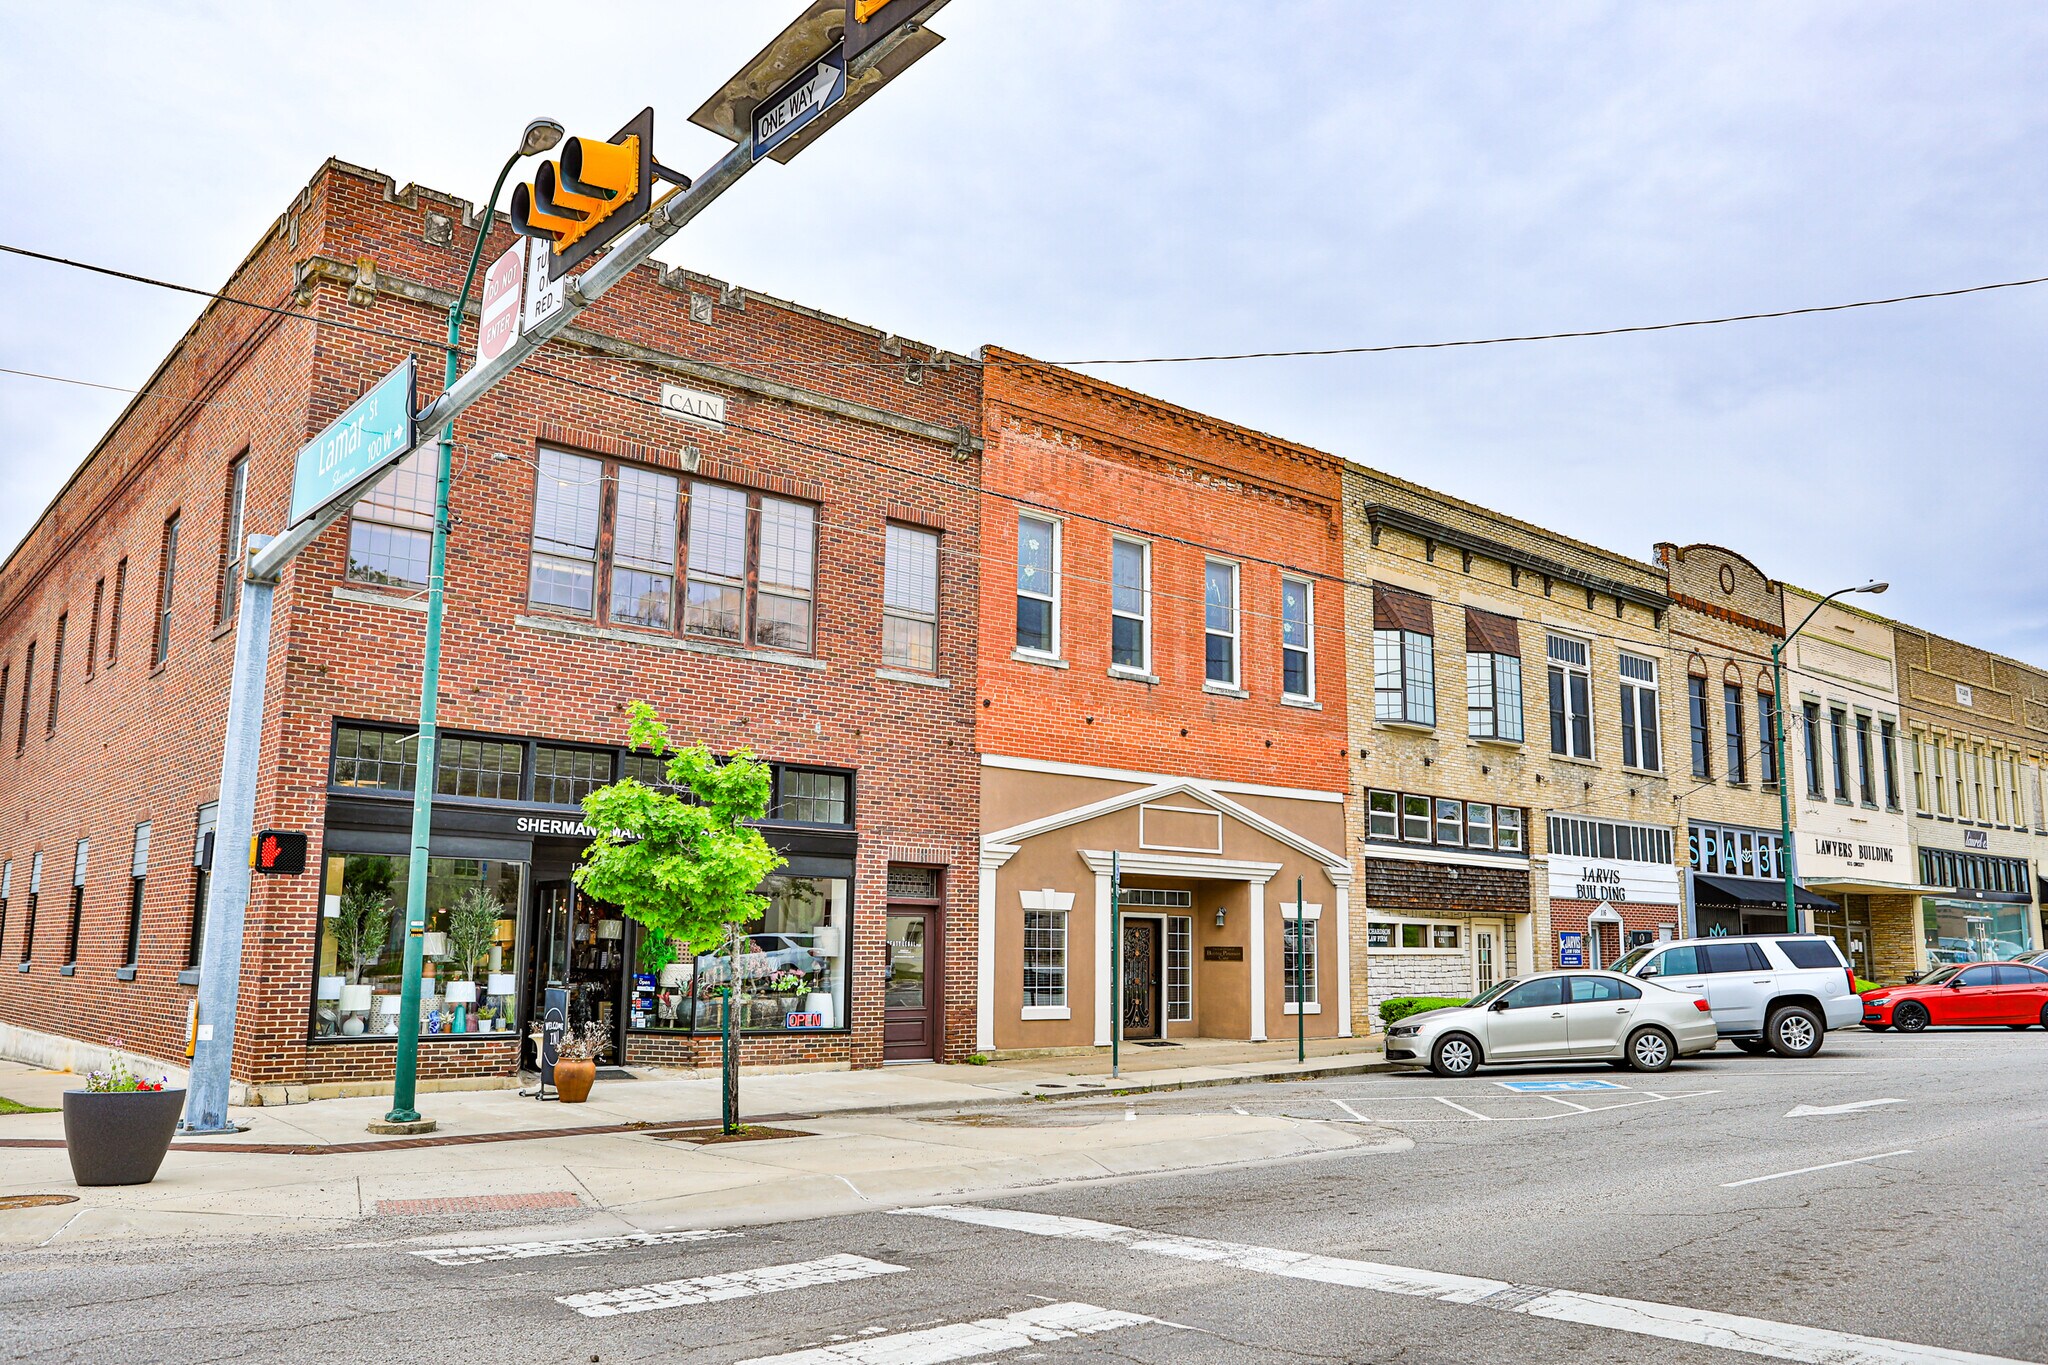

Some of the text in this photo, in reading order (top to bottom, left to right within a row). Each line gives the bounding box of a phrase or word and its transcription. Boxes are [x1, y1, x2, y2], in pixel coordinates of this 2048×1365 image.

[761, 81, 815, 138] ONE WAY
[488, 263, 518, 301] DO NOT
[535, 292, 553, 318] RED
[486, 313, 511, 345] ENTER
[669, 393, 718, 418] CAIN
[318, 397, 378, 477] Lamar St
[367, 428, 393, 463] 100 W
[516, 817, 597, 838] SHERMAN
[1688, 835, 1784, 872] SPA 31
[1814, 839, 1894, 863] LAWYERS BUILDING
[1582, 867, 1621, 884] JARVIS
[1576, 884, 1626, 901] BUILDING
[1565, 935, 1581, 949] JARVIS
[545, 1021, 564, 1031] WELCOME
[789, 1013, 821, 1027] OPEN
